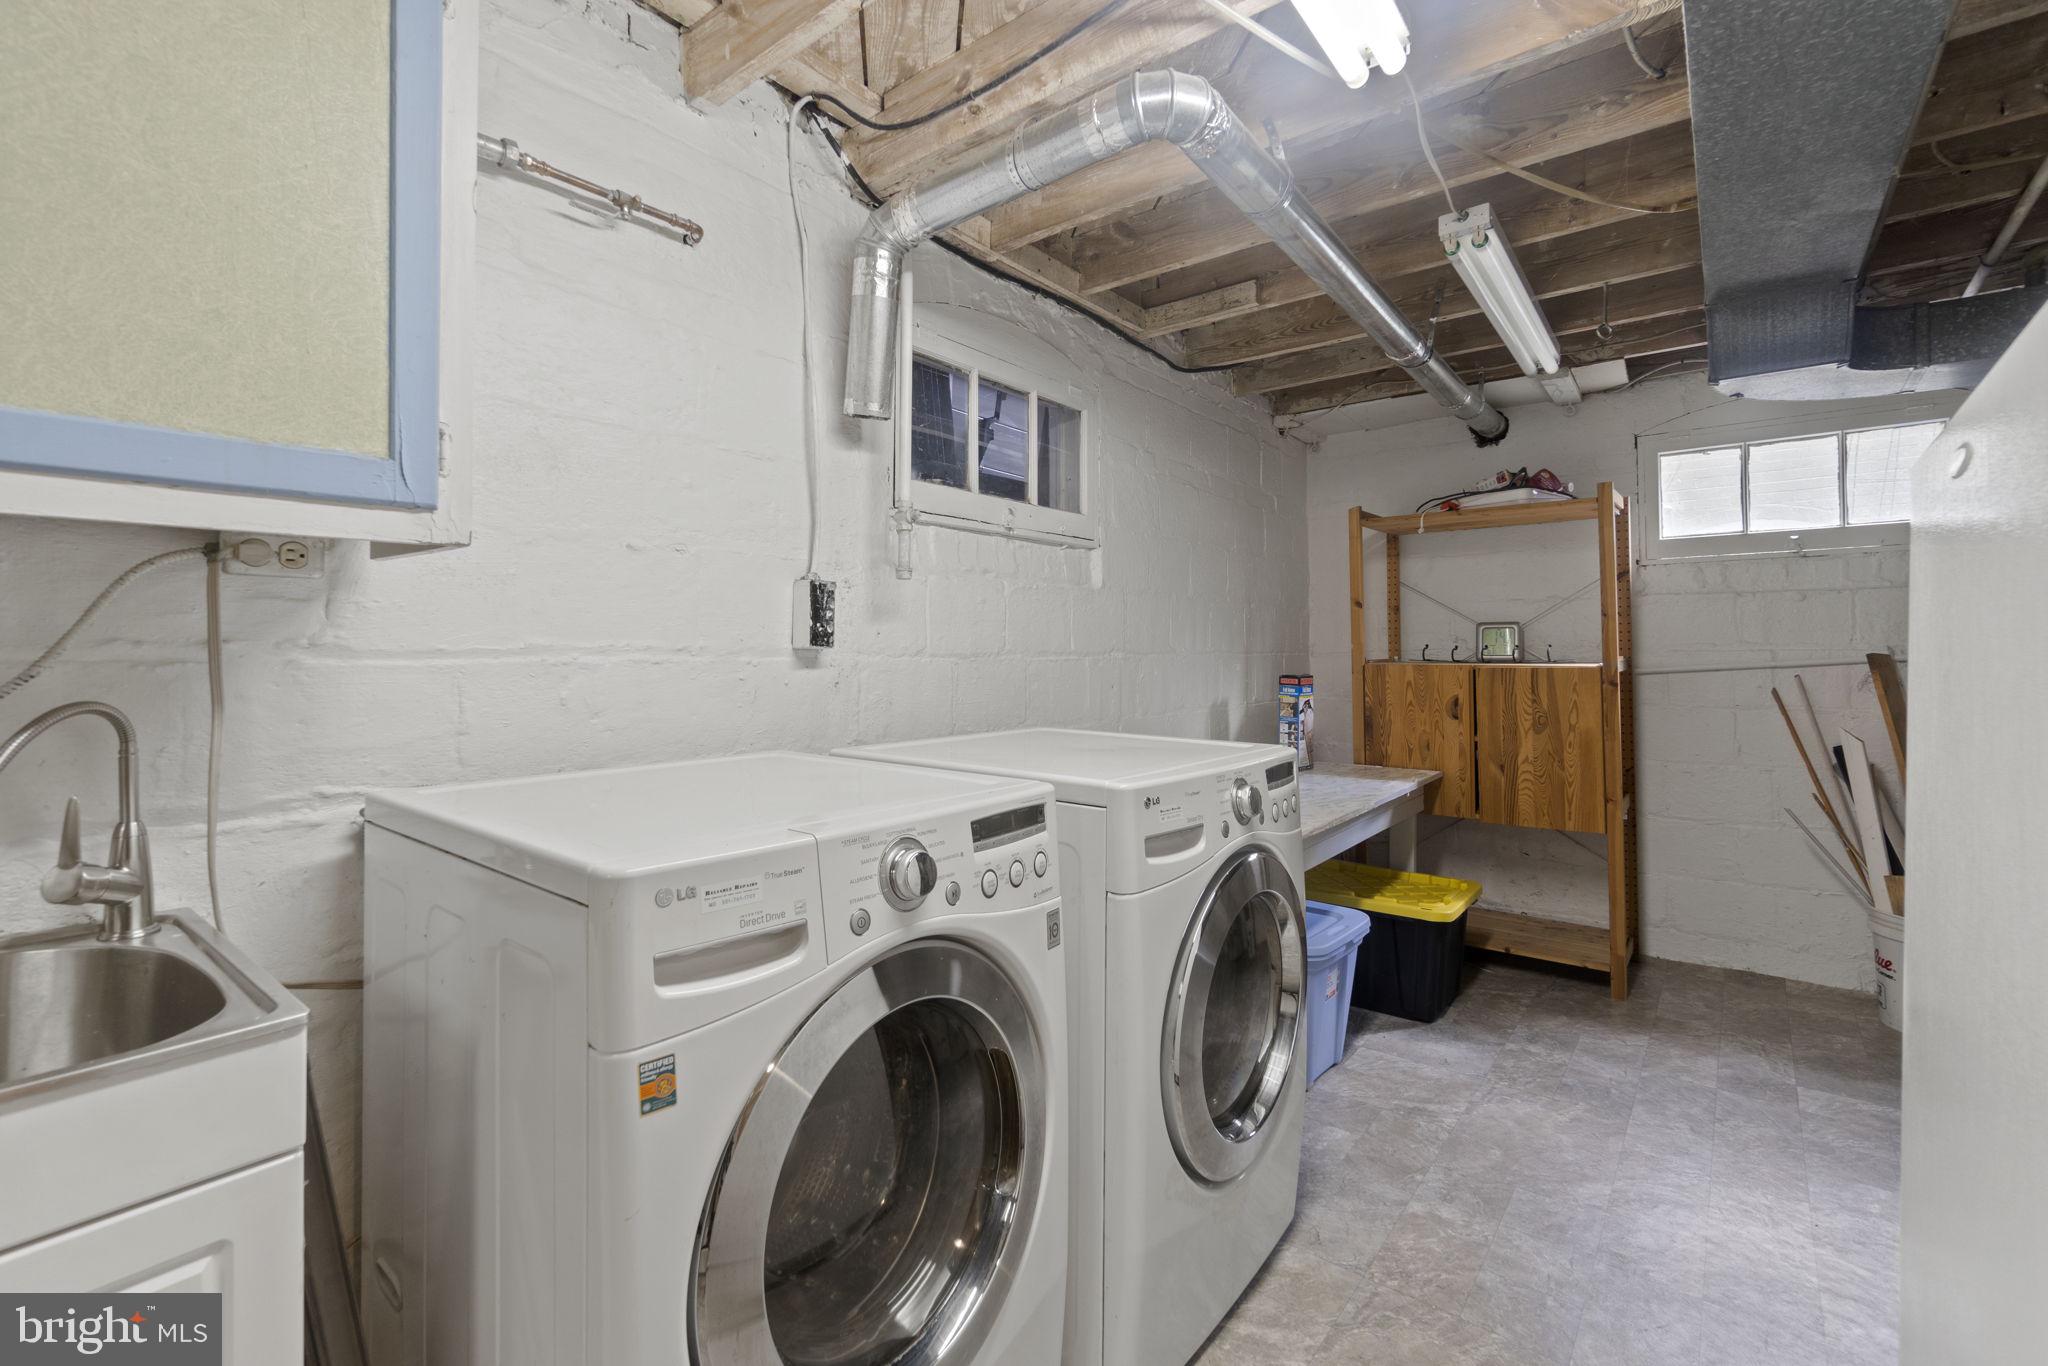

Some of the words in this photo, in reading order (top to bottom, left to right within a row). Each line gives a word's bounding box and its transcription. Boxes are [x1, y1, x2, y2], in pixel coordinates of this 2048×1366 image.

[1152, 796, 1161, 806] LG
[676, 886, 697, 902] LG
[740, 914, 764, 929] Direct
[765, 910, 786, 922] Drive
[640, 1056, 674, 1073] CERTIFIED
